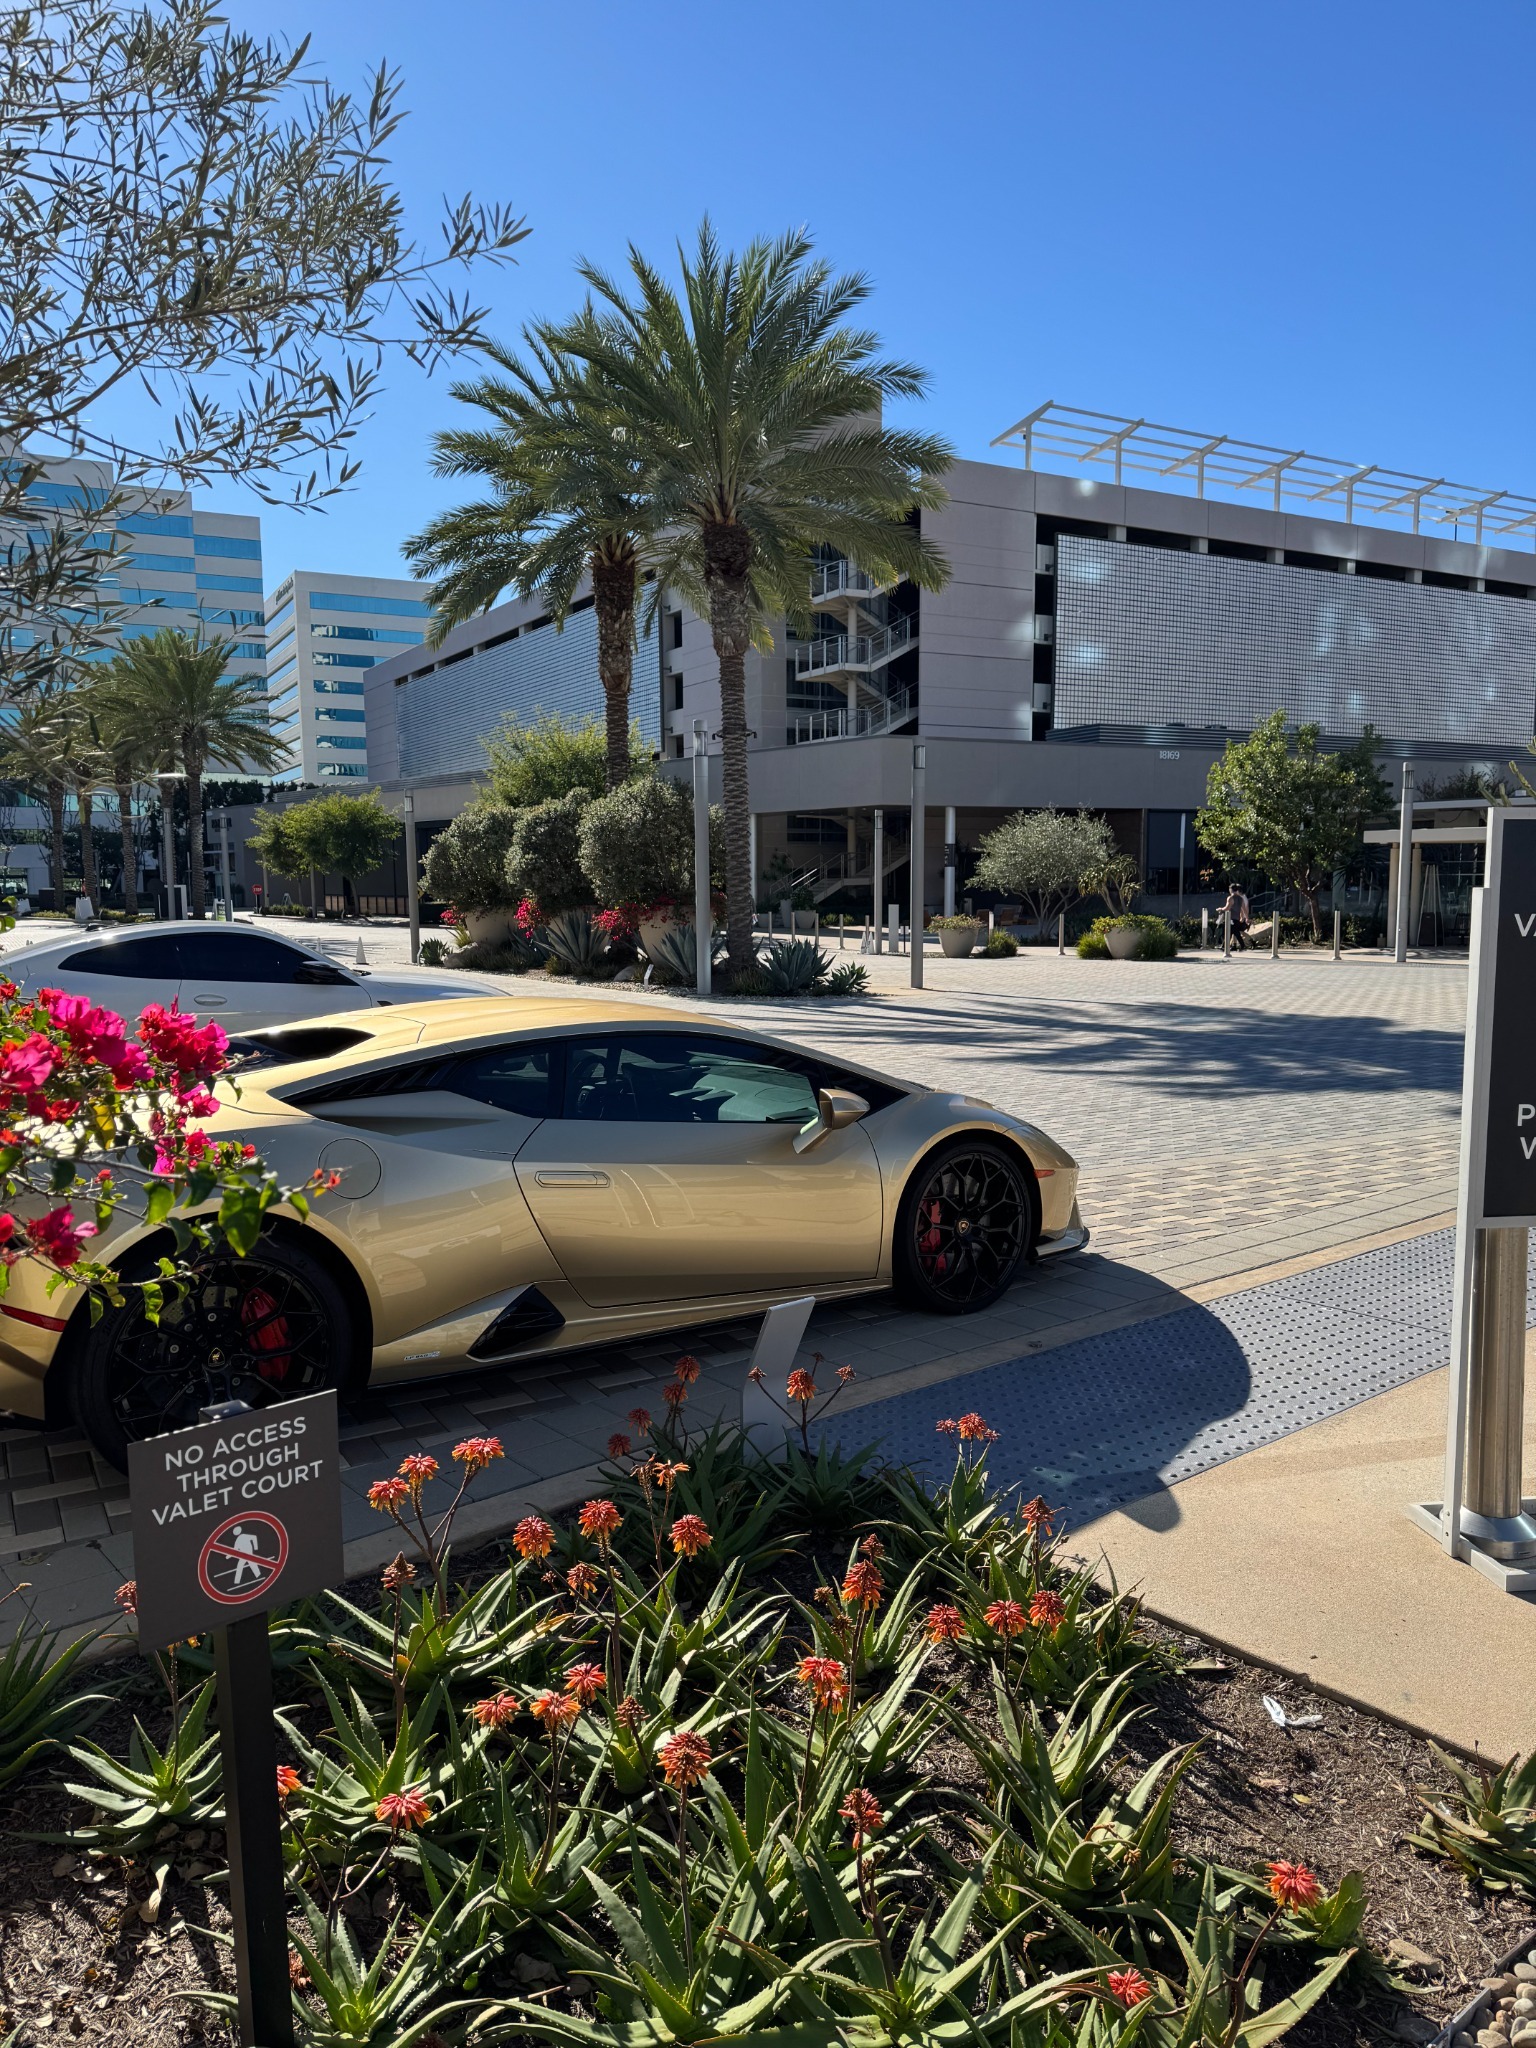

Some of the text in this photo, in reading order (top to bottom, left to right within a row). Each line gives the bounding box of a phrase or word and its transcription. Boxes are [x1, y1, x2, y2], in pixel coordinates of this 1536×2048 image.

[1160, 750, 1180, 760] 18169
[1514, 913, 1536, 937] V
[165, 1416, 307, 1471] NO ACCESS
[177, 1442, 300, 1492] THROUGH
[152, 1459, 324, 1526] VALET COURT
